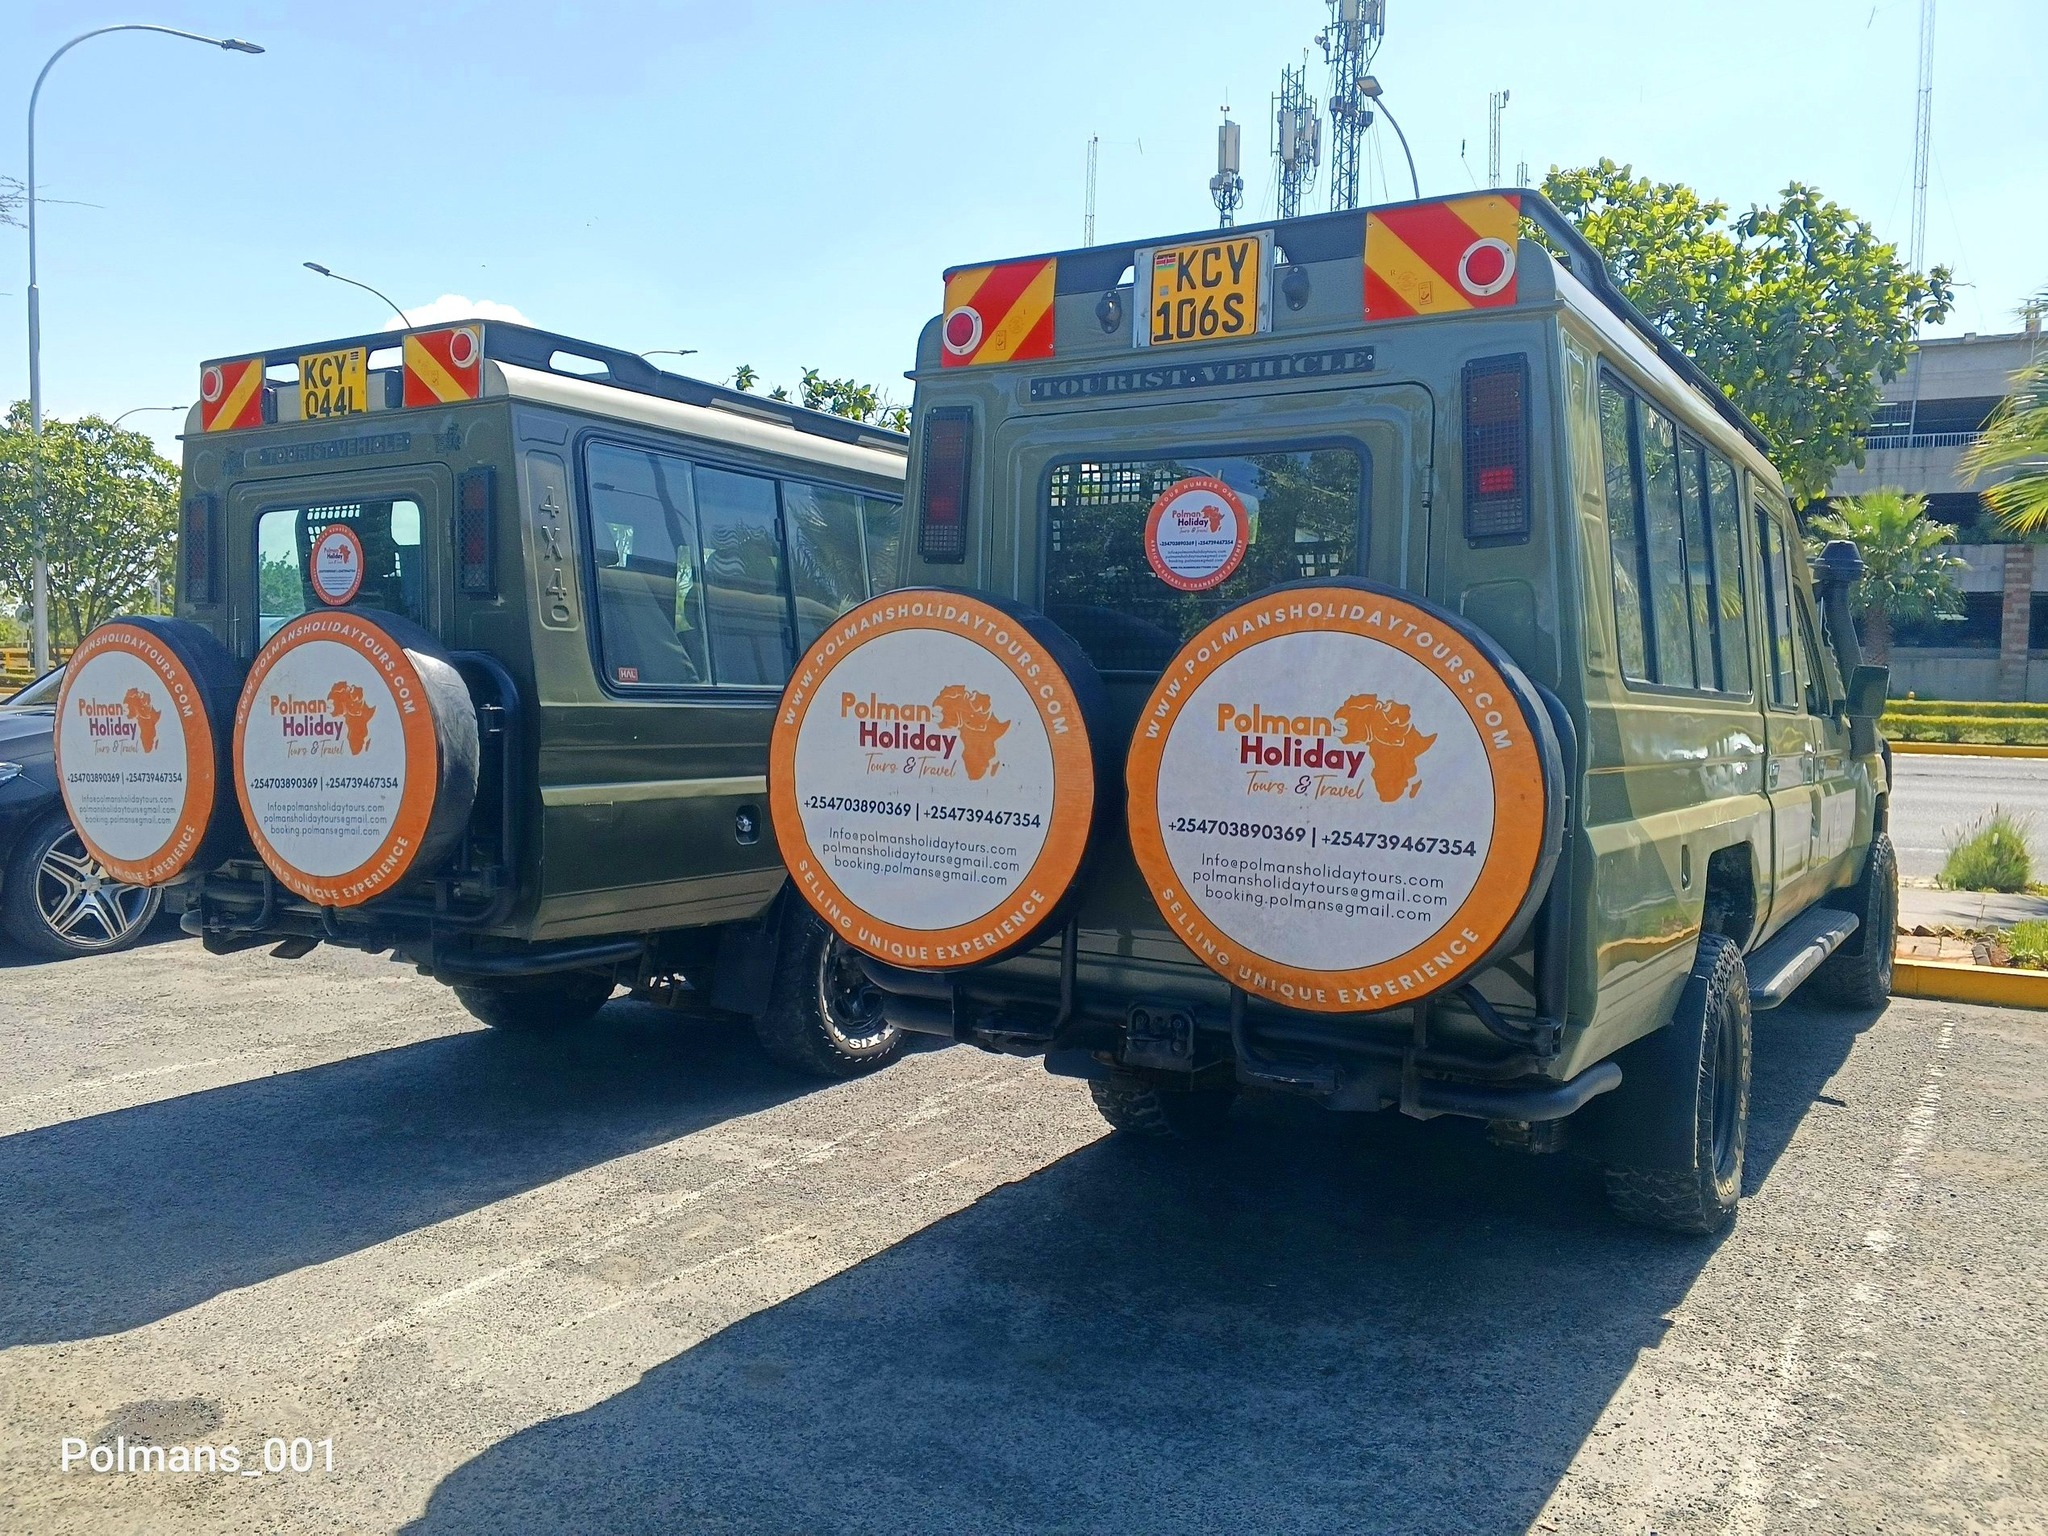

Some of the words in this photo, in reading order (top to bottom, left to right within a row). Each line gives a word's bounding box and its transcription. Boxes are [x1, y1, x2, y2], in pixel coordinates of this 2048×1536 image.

[1176, 242, 1249, 292] KCY
[1153, 292, 1245, 342] 106S
[304, 354, 347, 390] KCY
[1038, 368, 1189, 398] TOURIST
[1200, 351, 1366, 383] VEHICLE
[1177, 518, 1209, 528] Holiday
[784, 602, 1069, 736] WWW.POLMANSHOLIDAYTOURS.COM
[1145, 602, 1513, 750] WWW.POLMANSHOLIDAYTOURS.COM
[841, 691, 944, 724] Polmans
[1217, 703, 1349, 738] Polmans
[282, 714, 344, 741] Holiday
[859, 721, 957, 760] Holiday
[864, 751, 898, 777] Tours
[916, 755, 957, 778] Travel
[1240, 735, 1366, 779] Holiday
[250, 777, 318, 789] +254703890369
[325, 776, 399, 789] +254739467354
[1246, 770, 1289, 798] Tours
[1313, 774, 1365, 801] Travel
[803, 795, 911, 818] +254703890369
[923, 805, 1041, 829] +254739467354
[1168, 817, 1306, 843] +254703890369
[1321, 829, 1477, 857] +254739467354
[294, 879, 340, 900] UNIQUE
[343, 836, 409, 899] EXPERIENCE
[799, 858, 852, 930] SELLING
[858, 926, 929, 961] UNIQUE
[936, 888, 1045, 961] EXPERIENCE
[1162, 887, 1231, 967] SELLING
[1238, 964, 1327, 1004] UNIQUE
[1339, 927, 1479, 1004] EXPERIENCE
